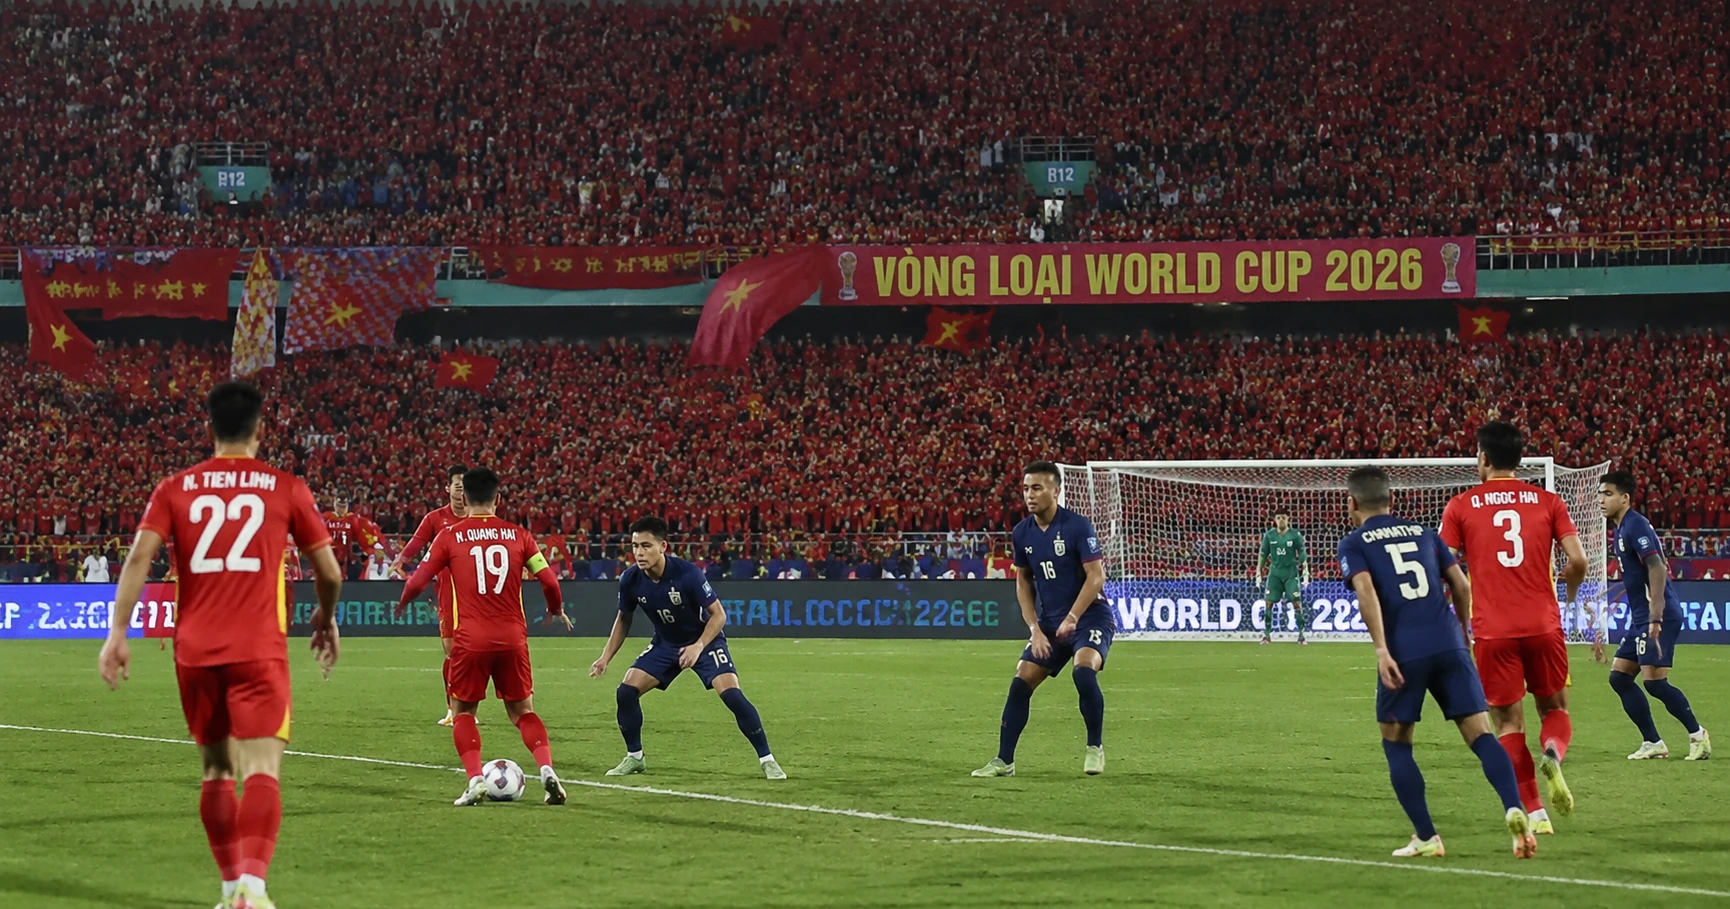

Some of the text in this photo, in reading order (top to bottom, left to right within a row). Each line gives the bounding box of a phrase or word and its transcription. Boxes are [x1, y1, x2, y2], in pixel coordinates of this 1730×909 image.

[1048, 167, 1074, 183] B12
[873, 247, 1423, 304] VÒNG LOẠI WORLD CUP 2026
[202, 471, 237, 488] TIEN
[1518, 491, 1539, 504] HAI
[189, 493, 265, 574] 22
[500, 528, 517, 541] HAI
[1493, 509, 1525, 568] 3
[469, 544, 509, 595] 19
[1040, 561, 1057, 580] 16
[1384, 541, 1430, 600] 5
[656, 608, 676, 624] 16
[1117, 598, 1242, 630] WORLD
